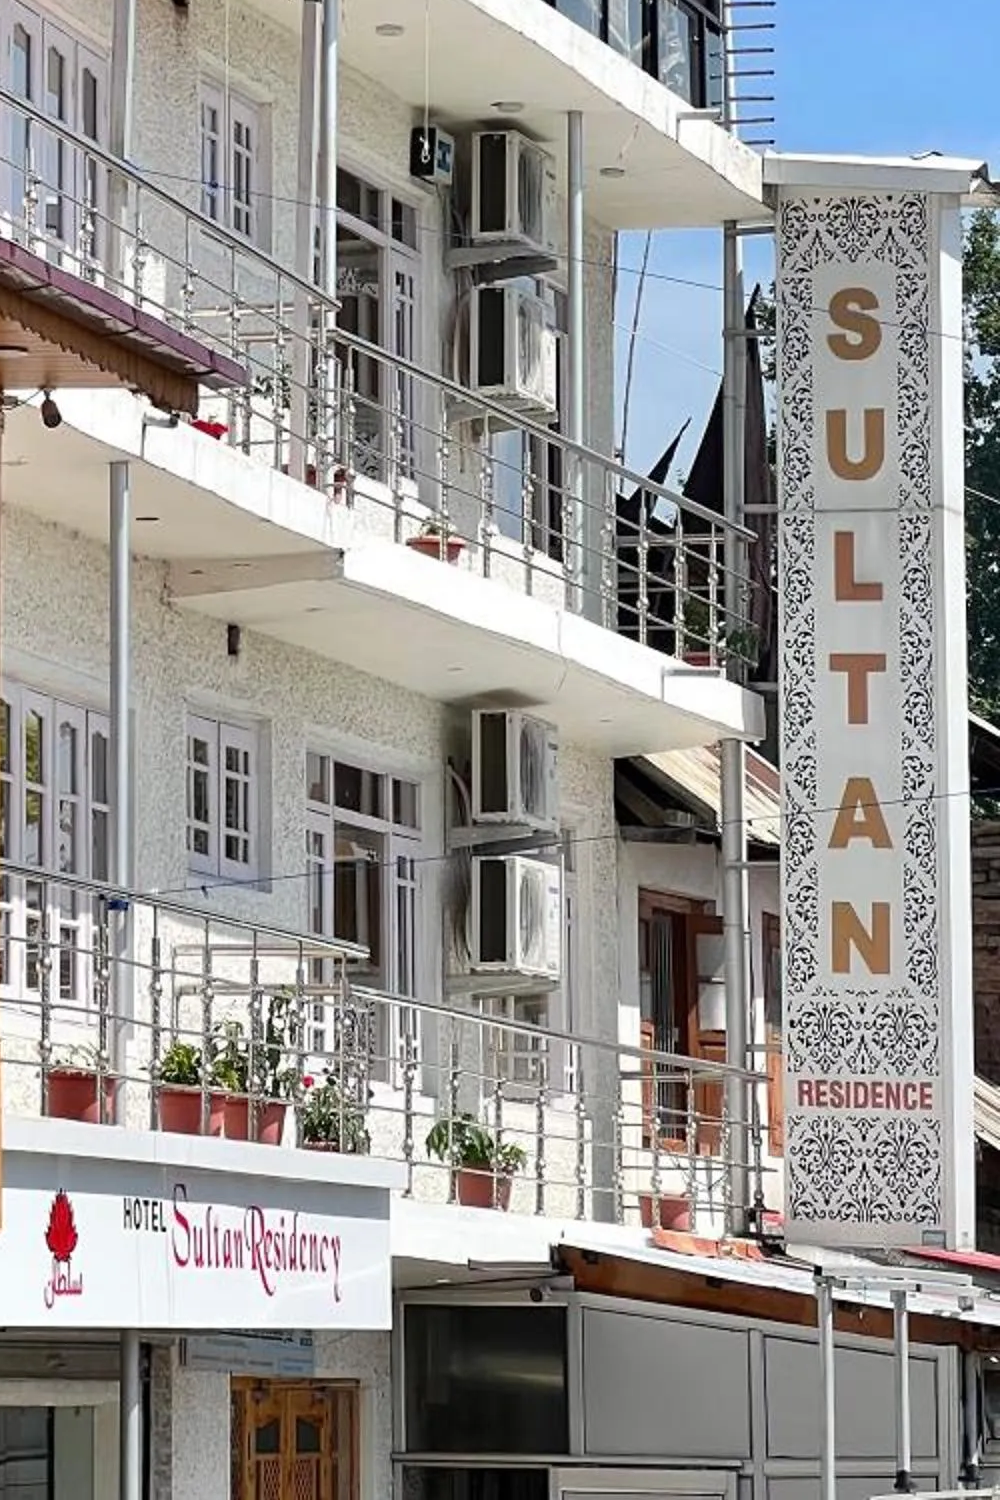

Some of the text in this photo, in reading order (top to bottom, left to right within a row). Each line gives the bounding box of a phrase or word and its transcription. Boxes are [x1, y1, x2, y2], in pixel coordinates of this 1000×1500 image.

[826, 287, 893, 975] SULTAN
[798, 1079, 934, 1110] RESIDENCE
[123, 1183, 341, 1303] HOTEL Sultan Residency
